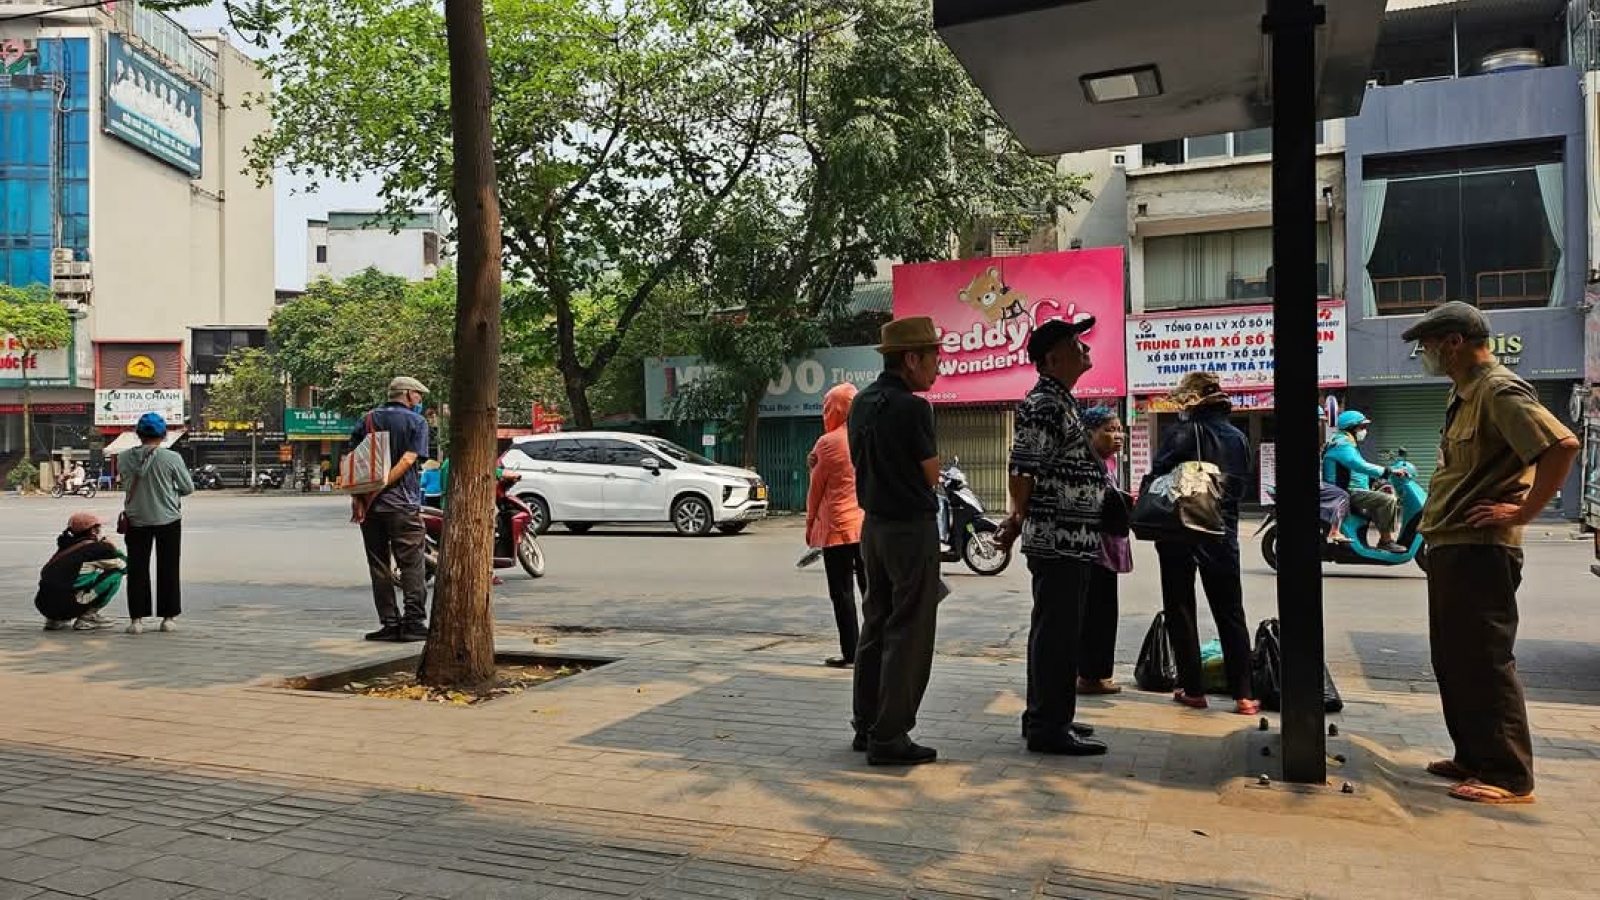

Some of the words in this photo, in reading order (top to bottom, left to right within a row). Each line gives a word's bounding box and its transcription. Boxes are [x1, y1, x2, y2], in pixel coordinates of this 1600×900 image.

[1231, 316, 1246, 329] XỔ
[1136, 339, 1180, 351] TRUNG
[1185, 335, 1216, 348] TÂM
[1221, 331, 1241, 347] XỔ
[1245, 330, 1265, 345] SỐ
[1147, 351, 1161, 362] XỔ
[1164, 350, 1177, 361] SỐ
[1180, 351, 1226, 360] VIETLOTT
[1233, 346, 1249, 359] XỔ
[1200, 361, 1228, 372] TÂM
[1231, 358, 1256, 371] TRẢ
